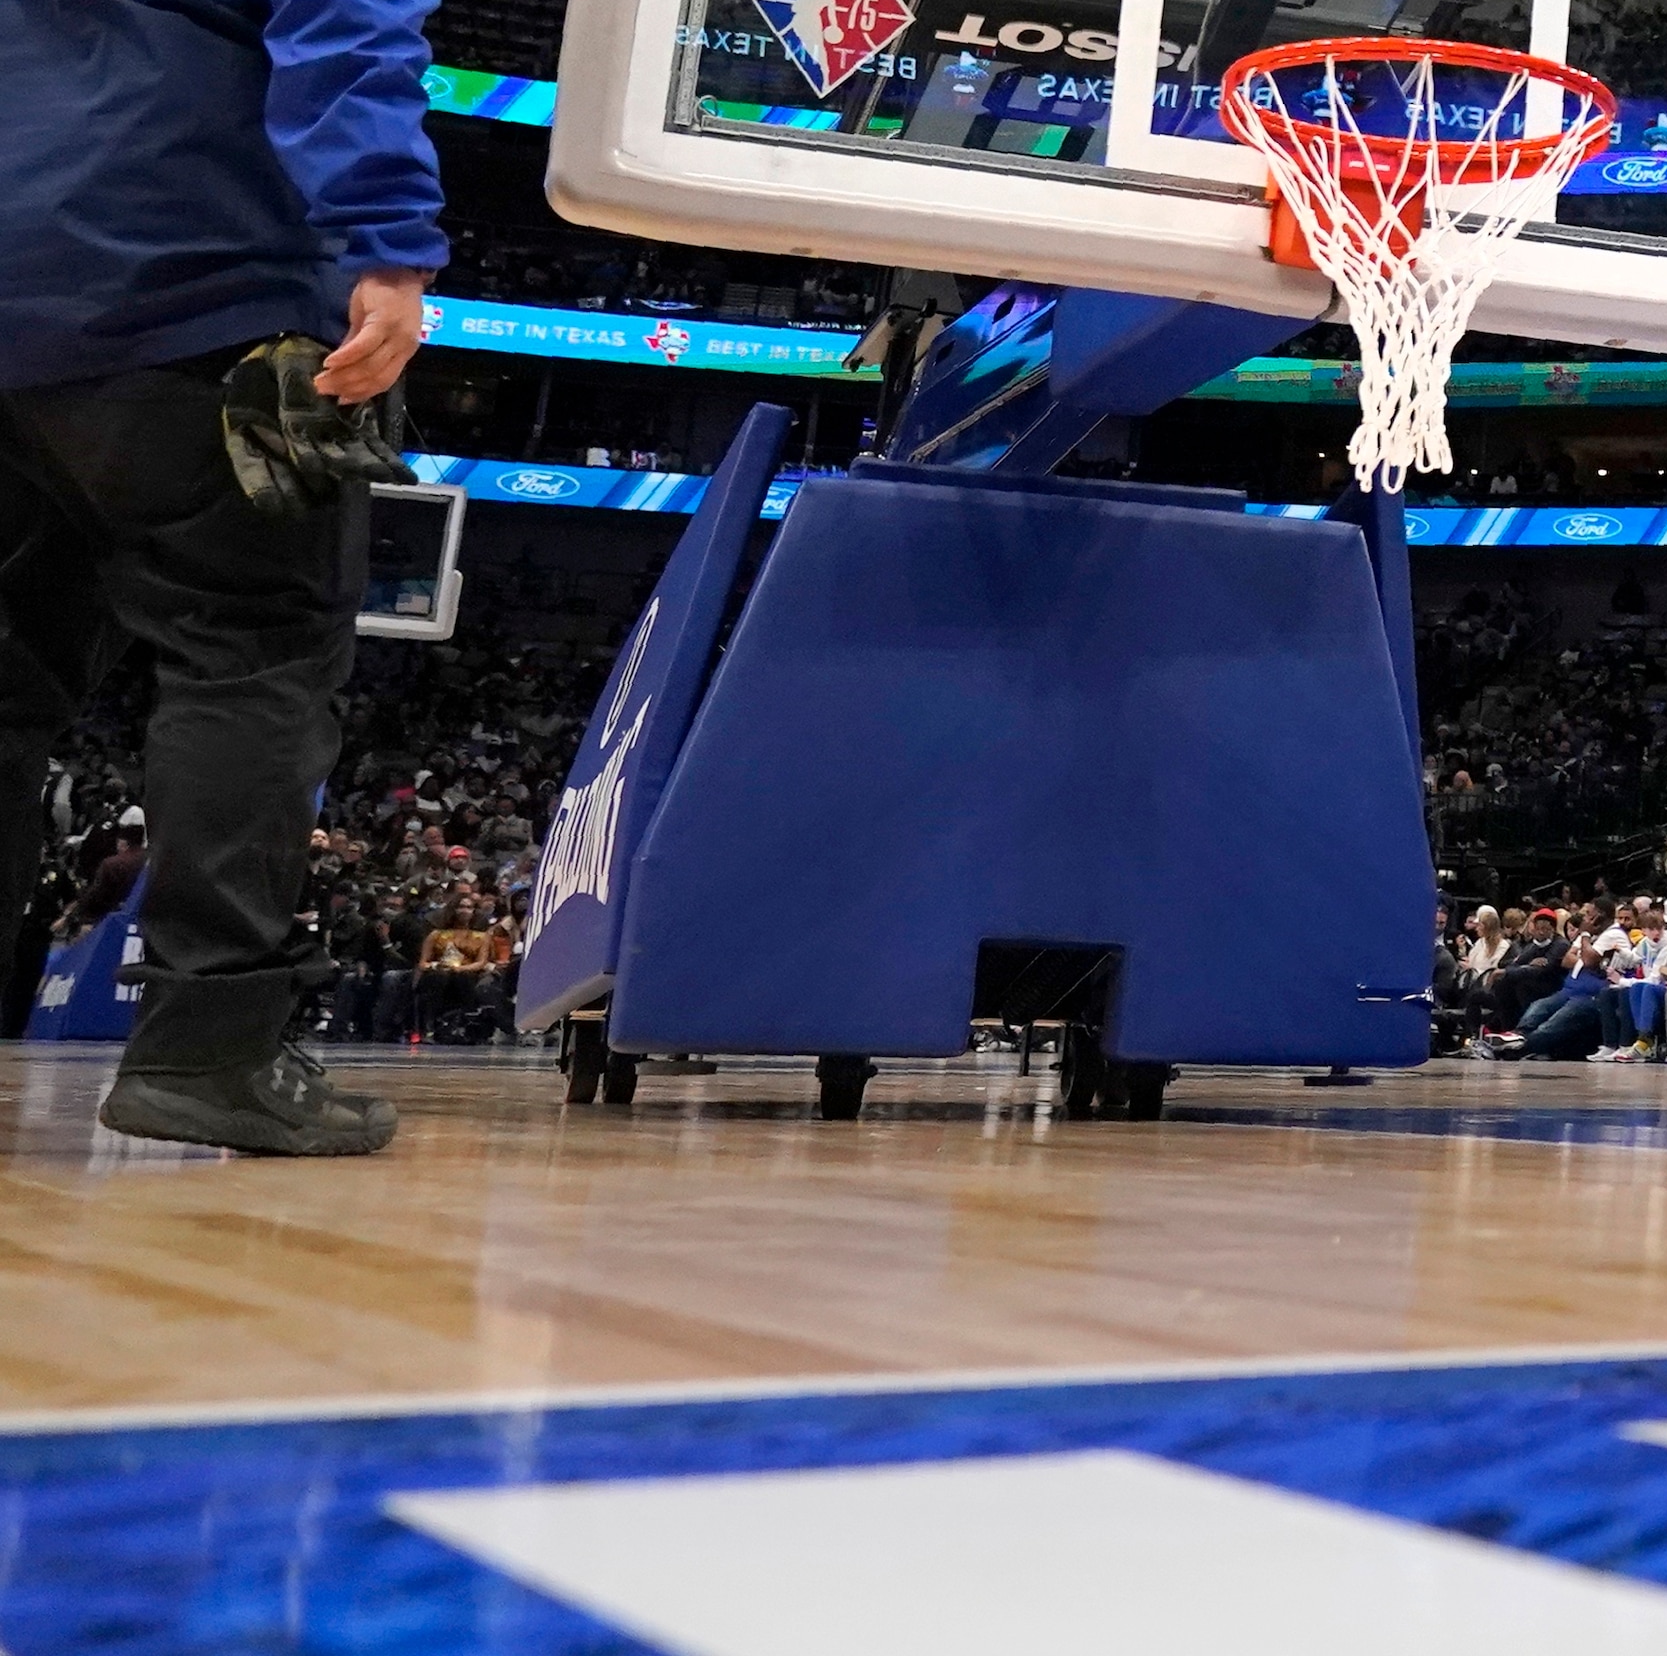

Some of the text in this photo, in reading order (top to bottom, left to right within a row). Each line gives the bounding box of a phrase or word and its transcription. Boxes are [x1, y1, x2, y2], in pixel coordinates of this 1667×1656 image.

[1616, 161, 1667, 183] Ford
[460, 317, 627, 347] BEST IN TEXAS
[511, 473, 564, 496] Ford
[1568, 515, 1608, 538] Ford
